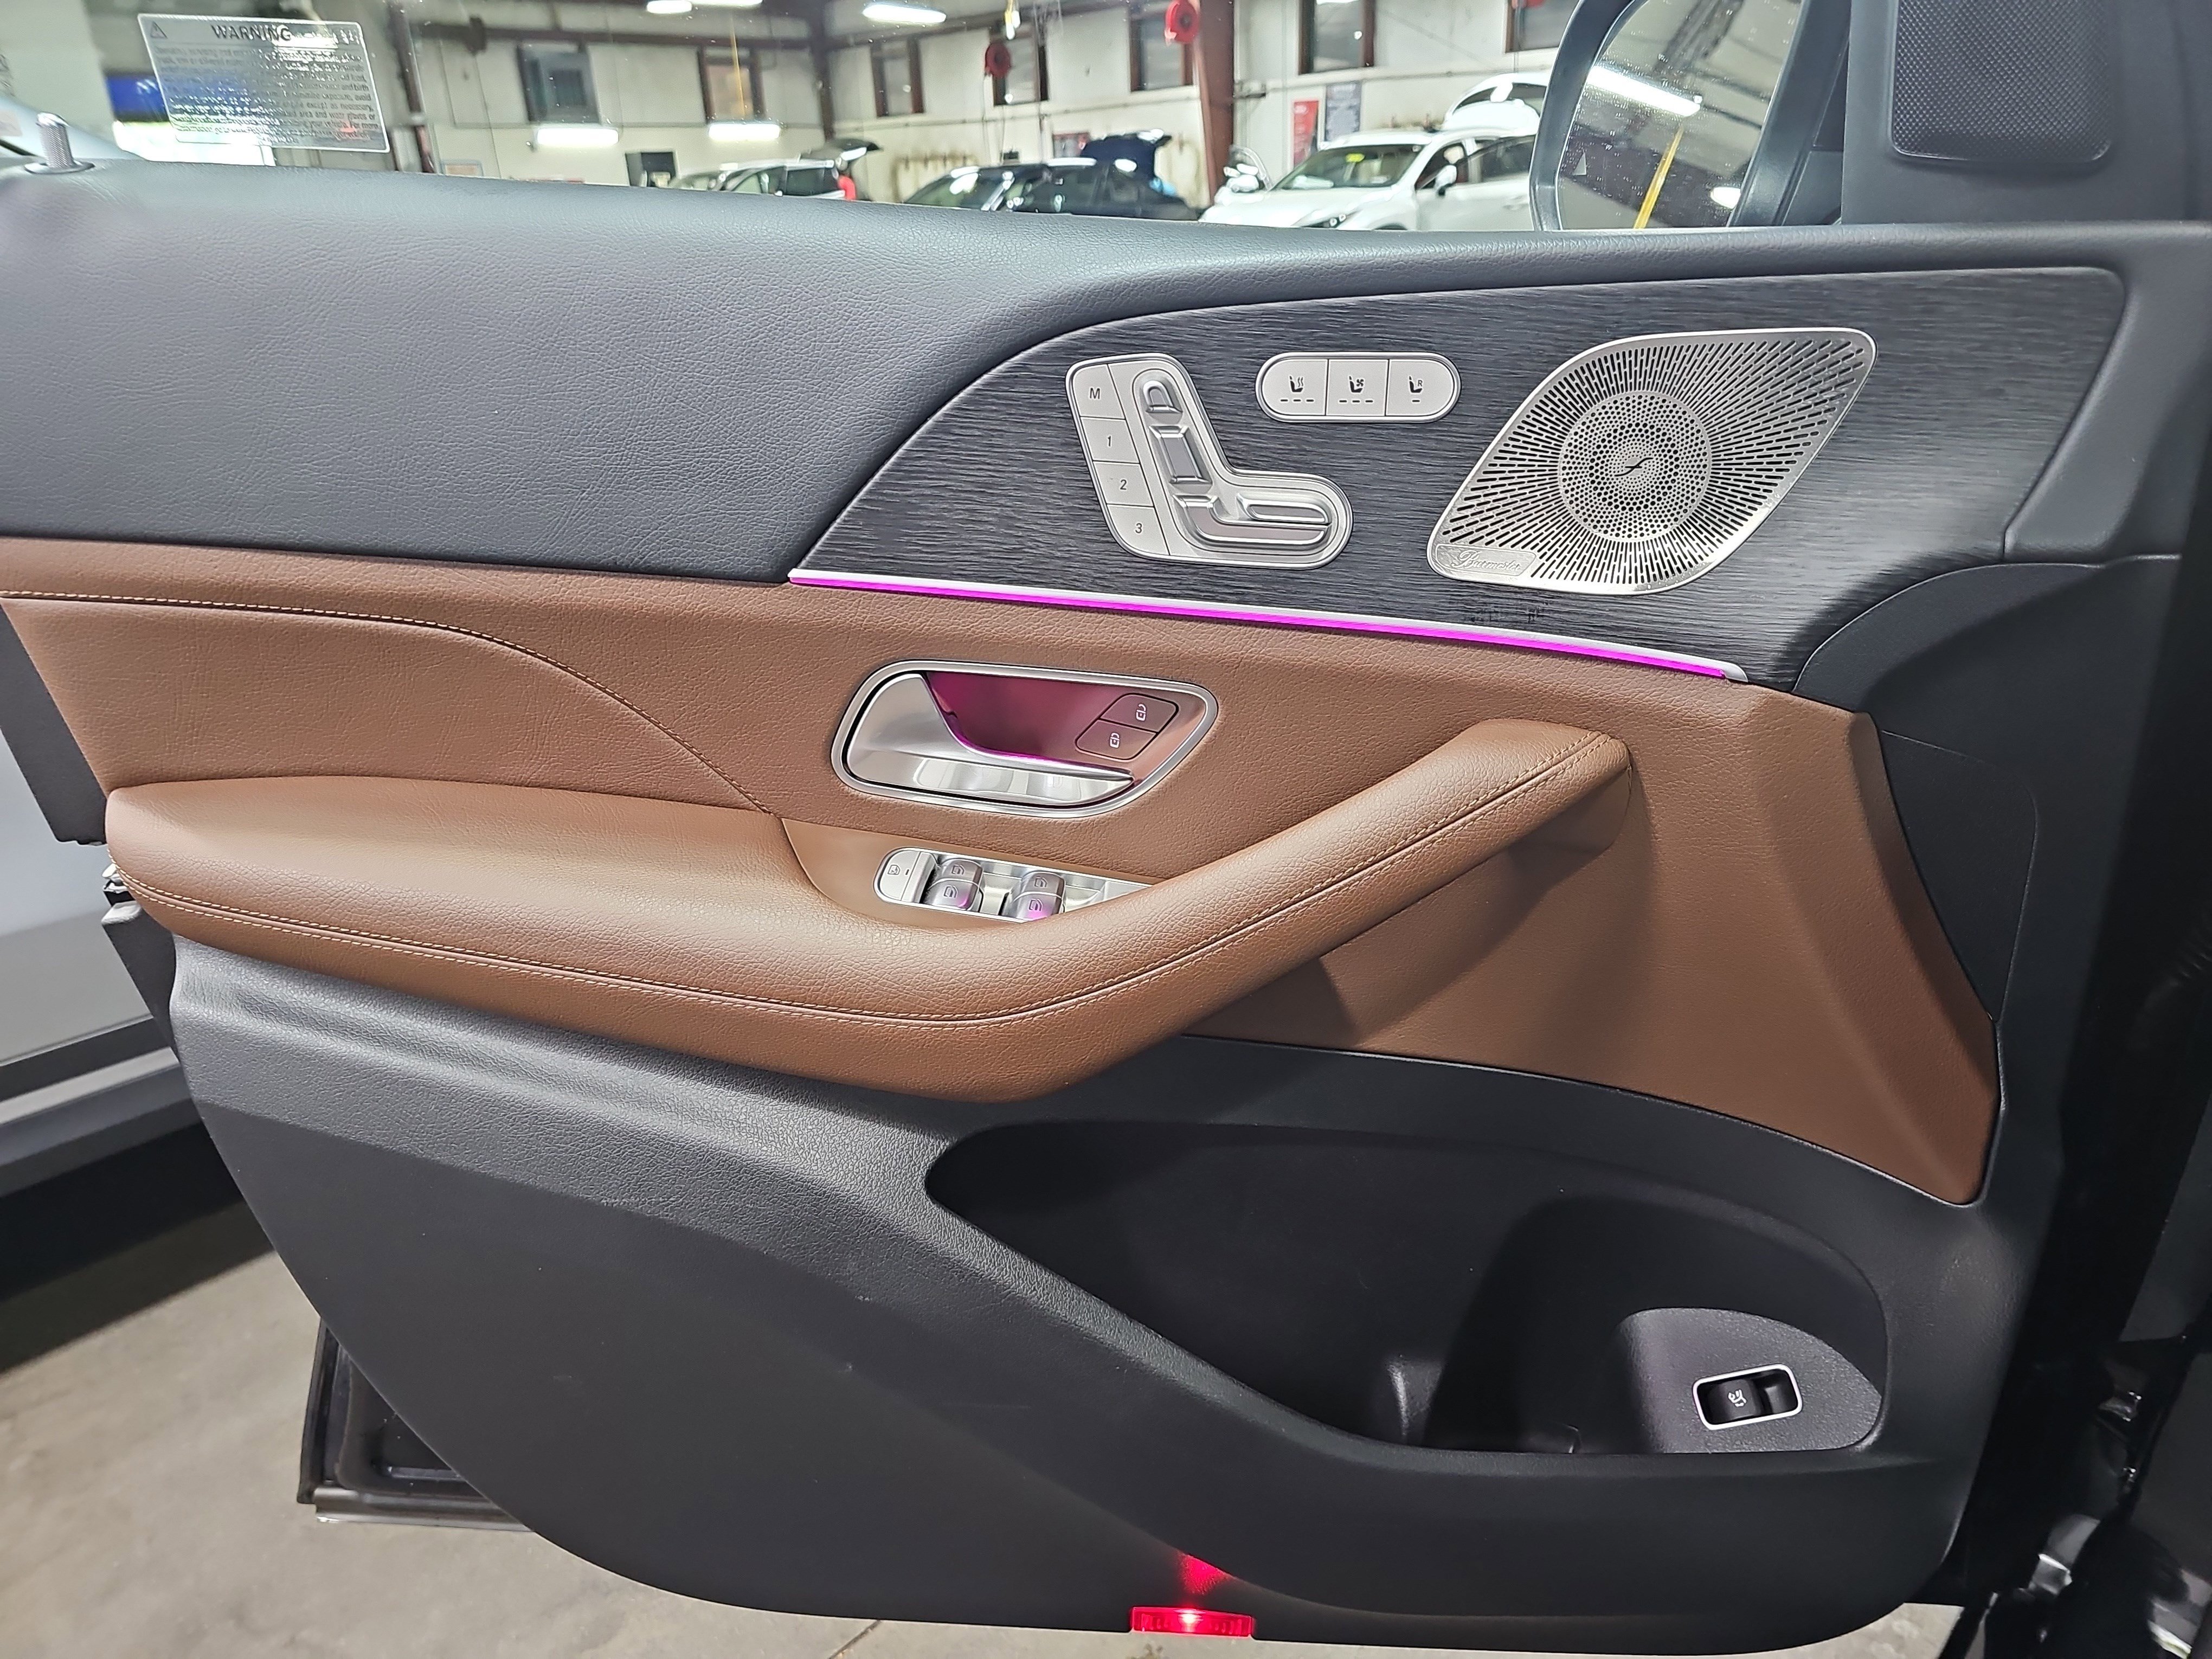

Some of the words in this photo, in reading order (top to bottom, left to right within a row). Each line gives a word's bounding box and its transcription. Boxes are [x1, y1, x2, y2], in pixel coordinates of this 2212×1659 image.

[210, 24, 292, 41] WARNING
[1089, 387, 1101, 400] M
[1107, 435, 1112, 447] 1
[1120, 479, 1127, 490] 2
[1135, 523, 1142, 533] 3
[1451, 549, 1521, 571] Burmester
